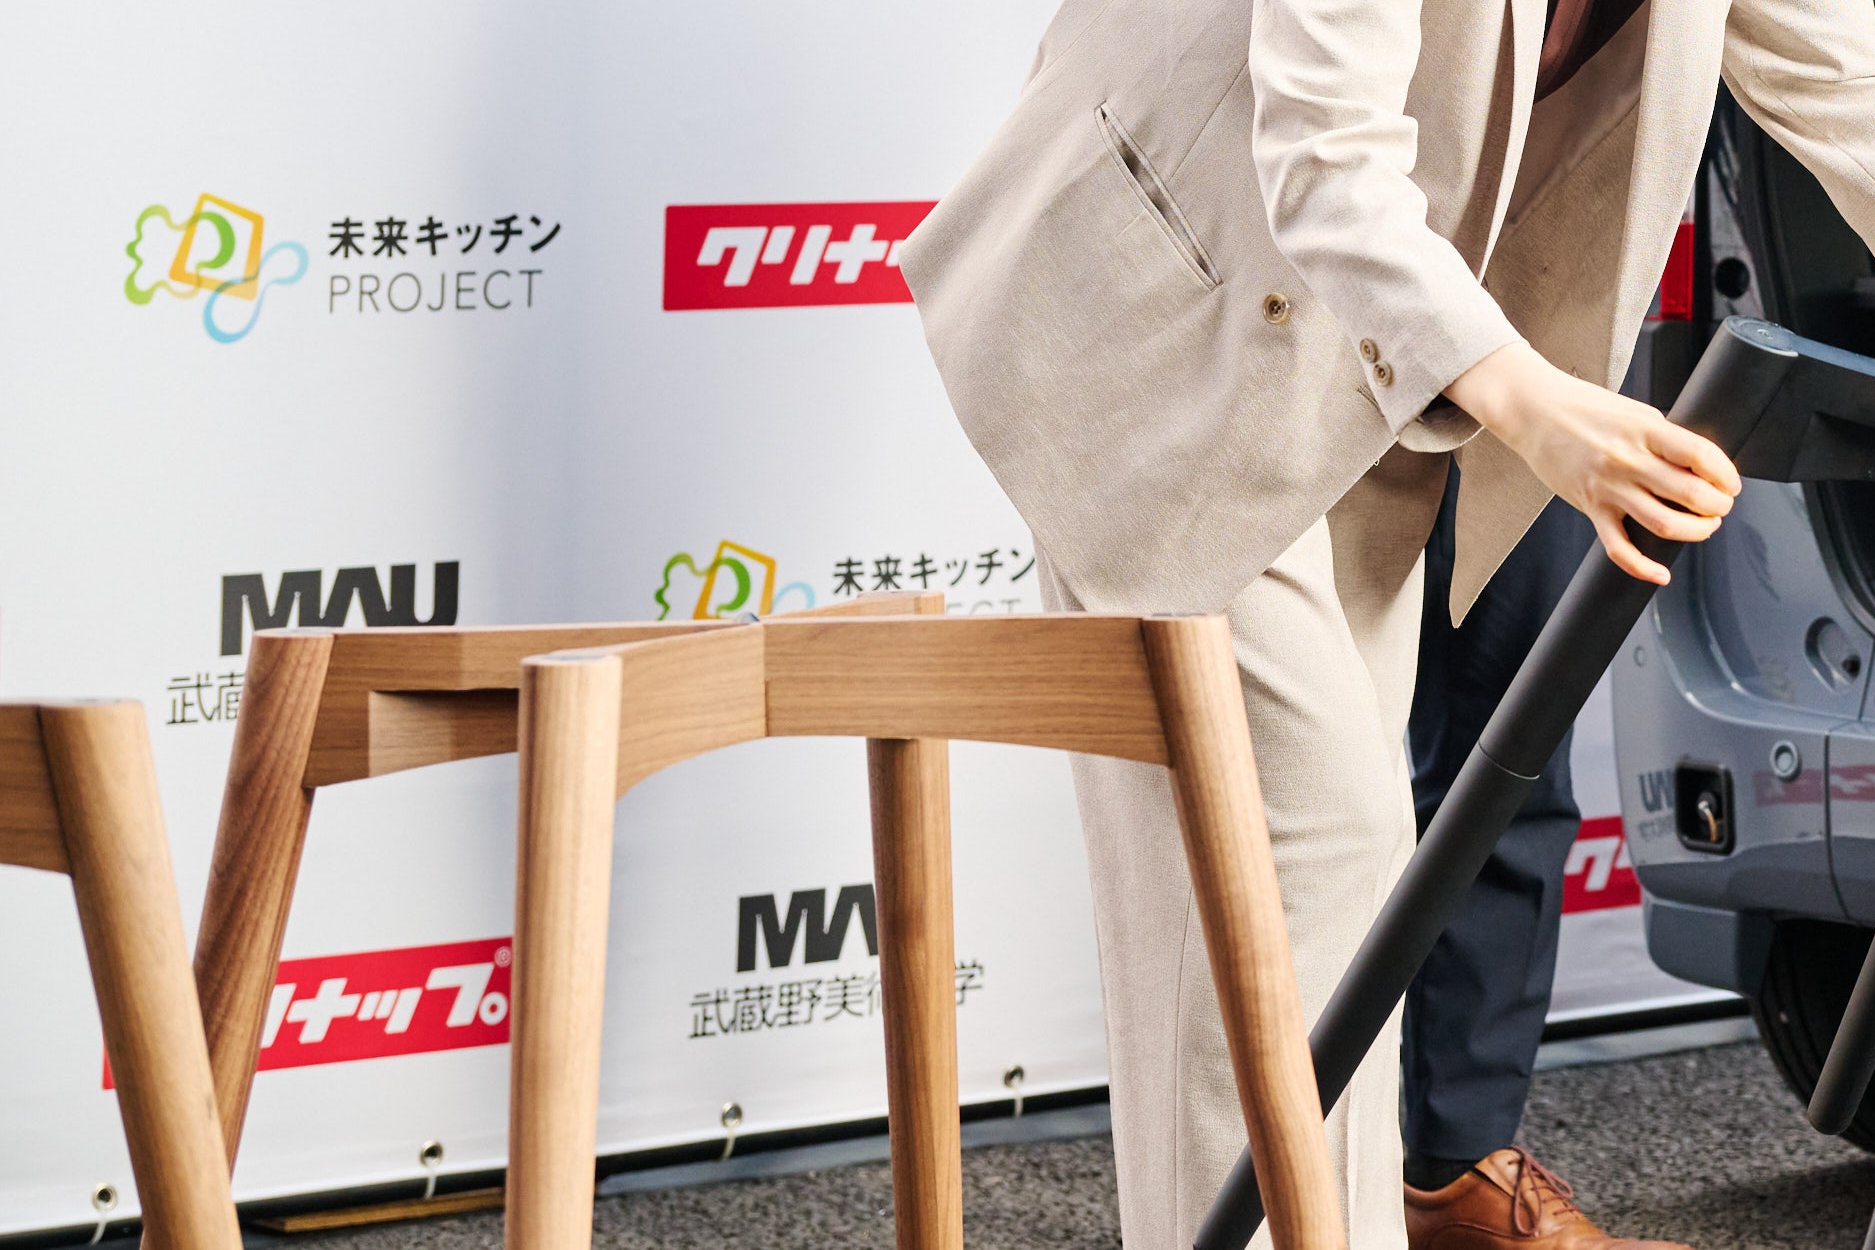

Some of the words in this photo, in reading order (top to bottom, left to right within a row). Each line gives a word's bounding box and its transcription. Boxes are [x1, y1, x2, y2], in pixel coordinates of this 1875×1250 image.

[328, 212, 563, 260] 未来キッチン
[329, 268, 544, 314] PROJECT
[833, 548, 1035, 596] 未来キッチン
[737, 884, 879, 973] MA
[688, 959, 985, 1040] 武蔵野美学
